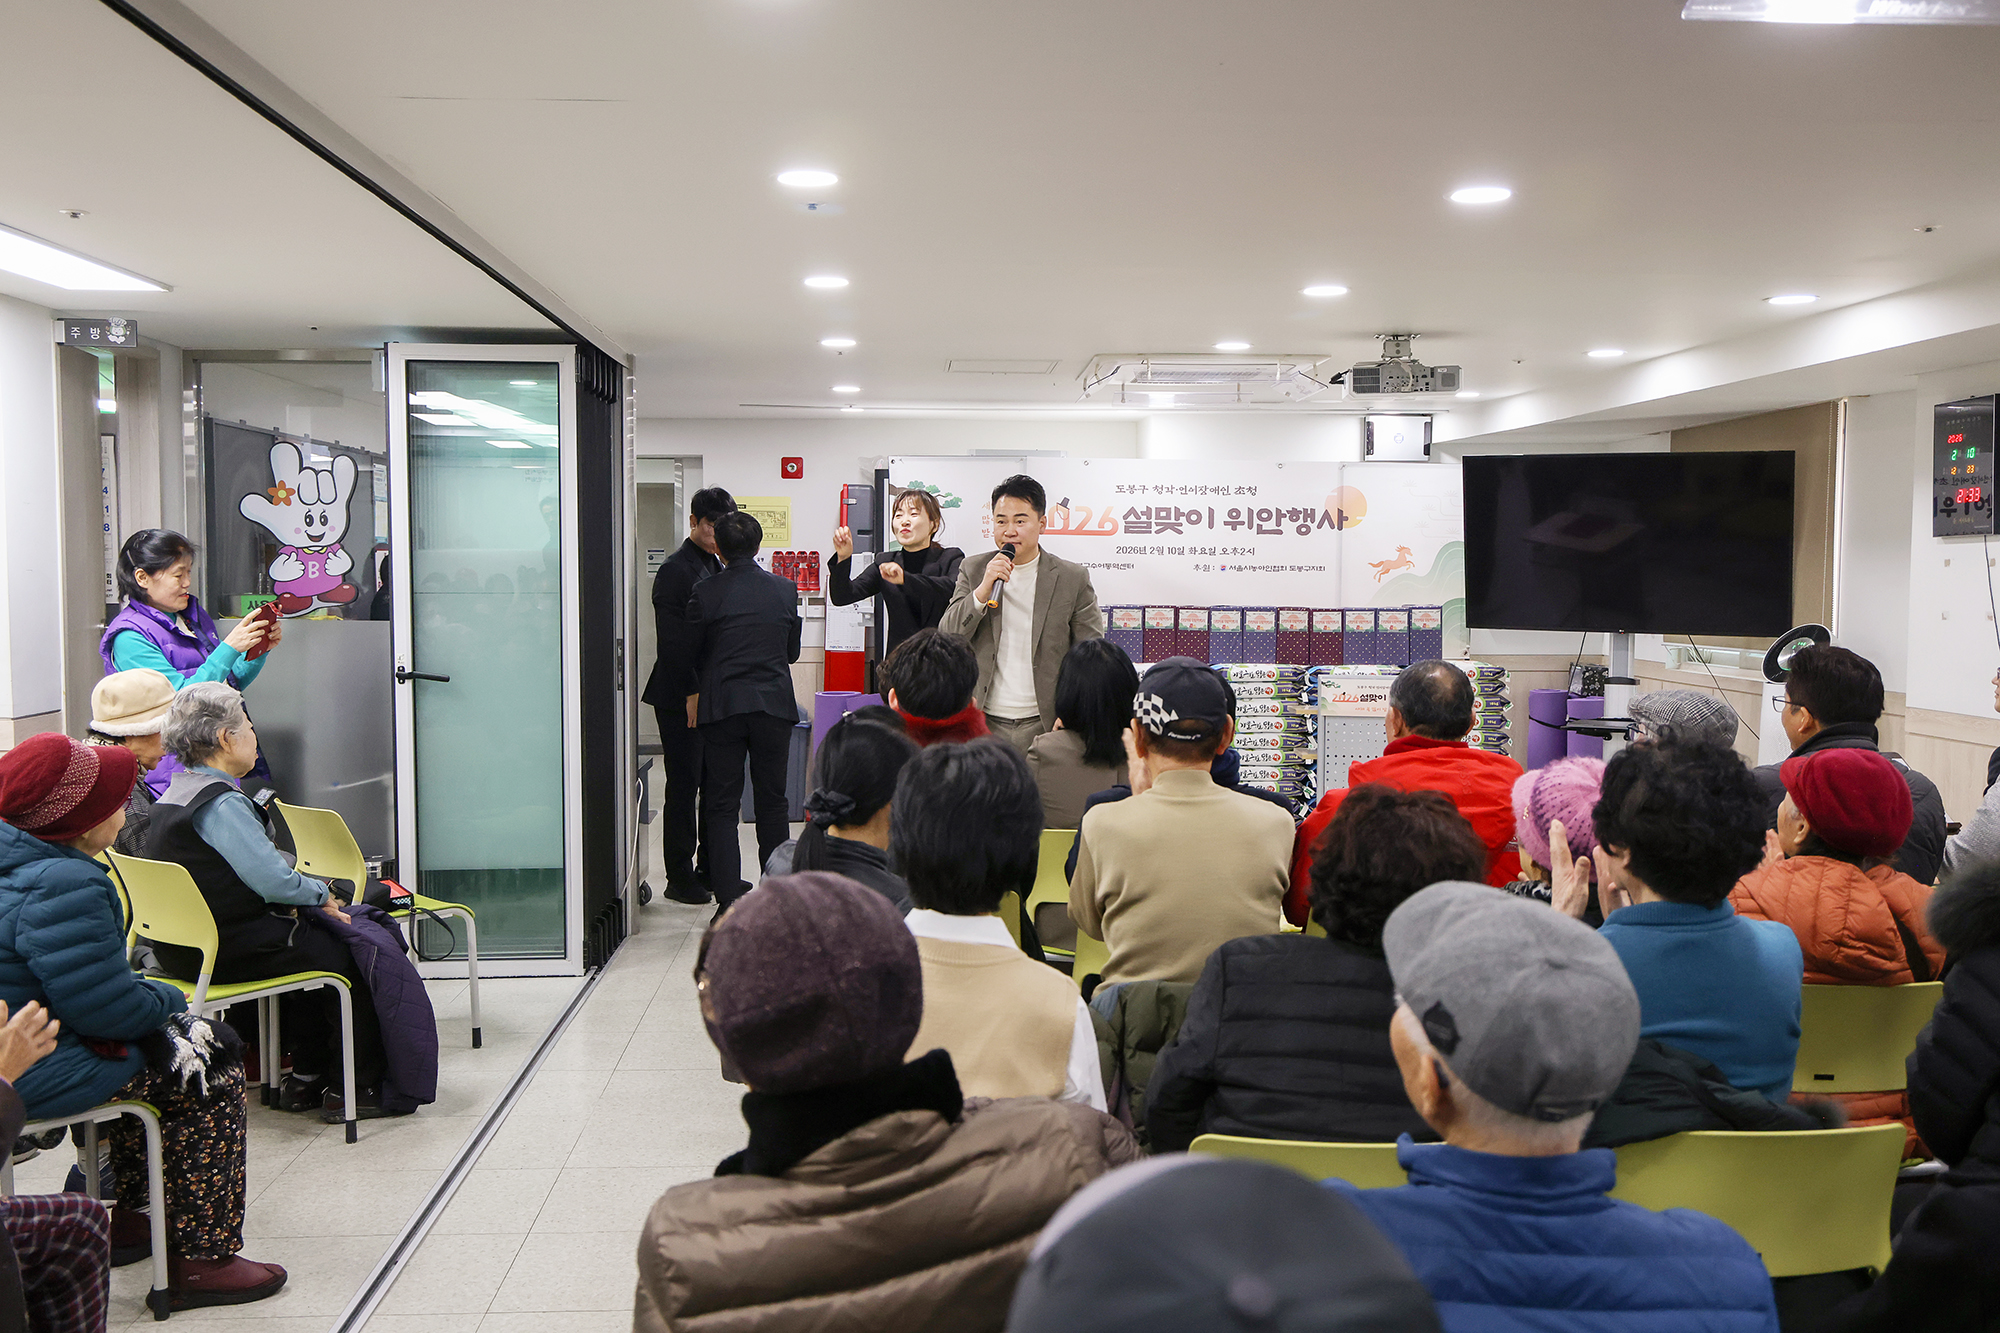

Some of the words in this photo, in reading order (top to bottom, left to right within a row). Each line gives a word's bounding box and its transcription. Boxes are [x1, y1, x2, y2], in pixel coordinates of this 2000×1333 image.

[1947, 433, 1964, 445] 2026
[1951, 449, 1959, 462] 2
[1966, 447, 1977, 460] 10
[1966, 464, 1976, 475] 23
[1115, 484, 1149, 495] 도봉구
[1234, 485, 1258, 497] 초청
[1956, 487, 1981, 504] 2:33
[1043, 505, 1119, 536] 026
[1122, 505, 1215, 535] 설맞이
[1223, 506, 1349, 536] 위안행사
[1115, 546, 1147, 556] 2026년
[1149, 546, 1165, 556] 2월
[1167, 547, 1185, 556] 10일
[1188, 547, 1217, 557] 화요일
[308, 561, 320, 579] B
[1080, 562, 1135, 571] 구수어통역센터
[1289, 565, 1326, 573] 도봉구지회
[1332, 694, 1359, 703] 2026
[1360, 694, 1387, 703] 설맞이
